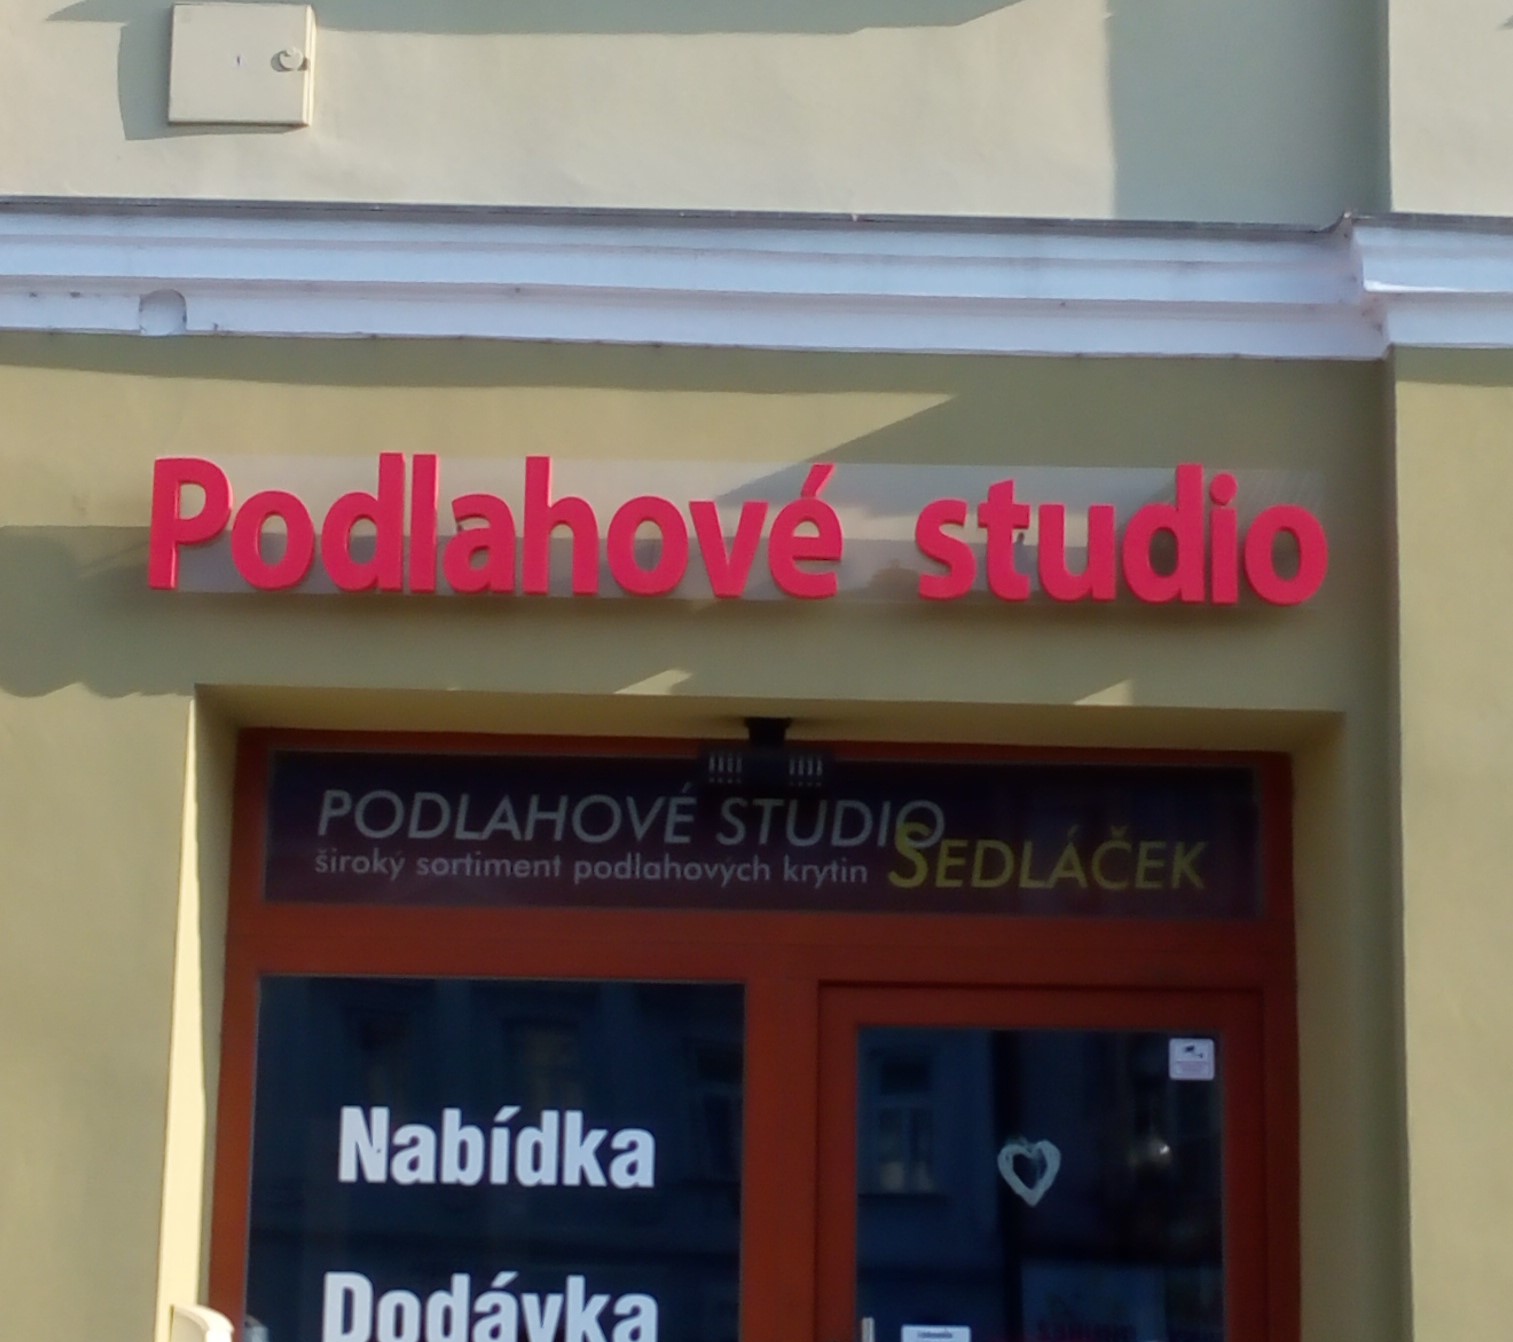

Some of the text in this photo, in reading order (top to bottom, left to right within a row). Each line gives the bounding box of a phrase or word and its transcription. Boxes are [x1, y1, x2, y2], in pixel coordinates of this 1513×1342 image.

[147, 451, 1331, 605] Podlahové studio
[317, 783, 945, 849] PODLAHOVÉ STUDIO
[314, 847, 869, 890] široký sortiment podlahových krytin
[887, 820, 1209, 890] SEDLÁČEK
[338, 1105, 657, 1189] Nabídka
